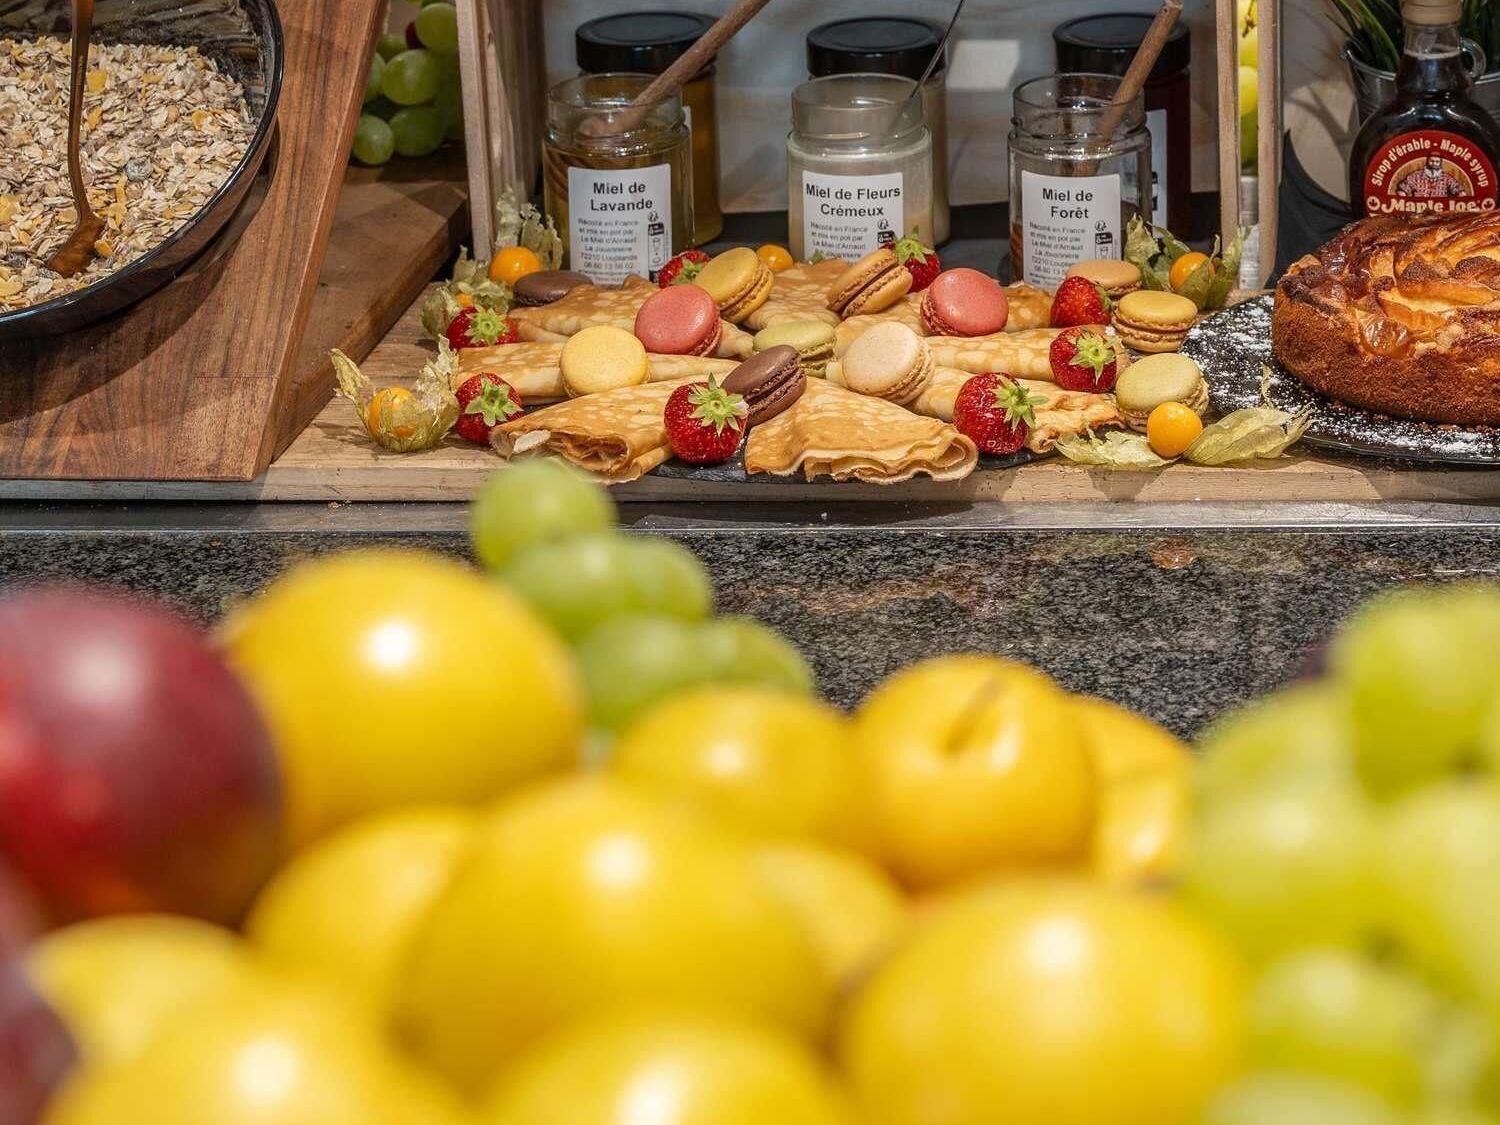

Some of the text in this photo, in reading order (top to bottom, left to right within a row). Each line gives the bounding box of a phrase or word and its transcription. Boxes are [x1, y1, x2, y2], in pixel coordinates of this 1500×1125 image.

[1371, 159, 1392, 187] Sirop
[1388, 138, 1431, 163] d'érable
[1440, 139, 1471, 161] Maple
[1469, 158, 1489, 188] syrup
[593, 182, 646, 194] Miel de
[806, 183, 901, 200] Miel de Fleurs
[1042, 188, 1093, 201] Miel de
[590, 198, 653, 211] Lavande
[820, 203, 884, 216] Crémeux
[1381, 198, 1444, 213] Maple
[1051, 206, 1089, 219] Forêt
